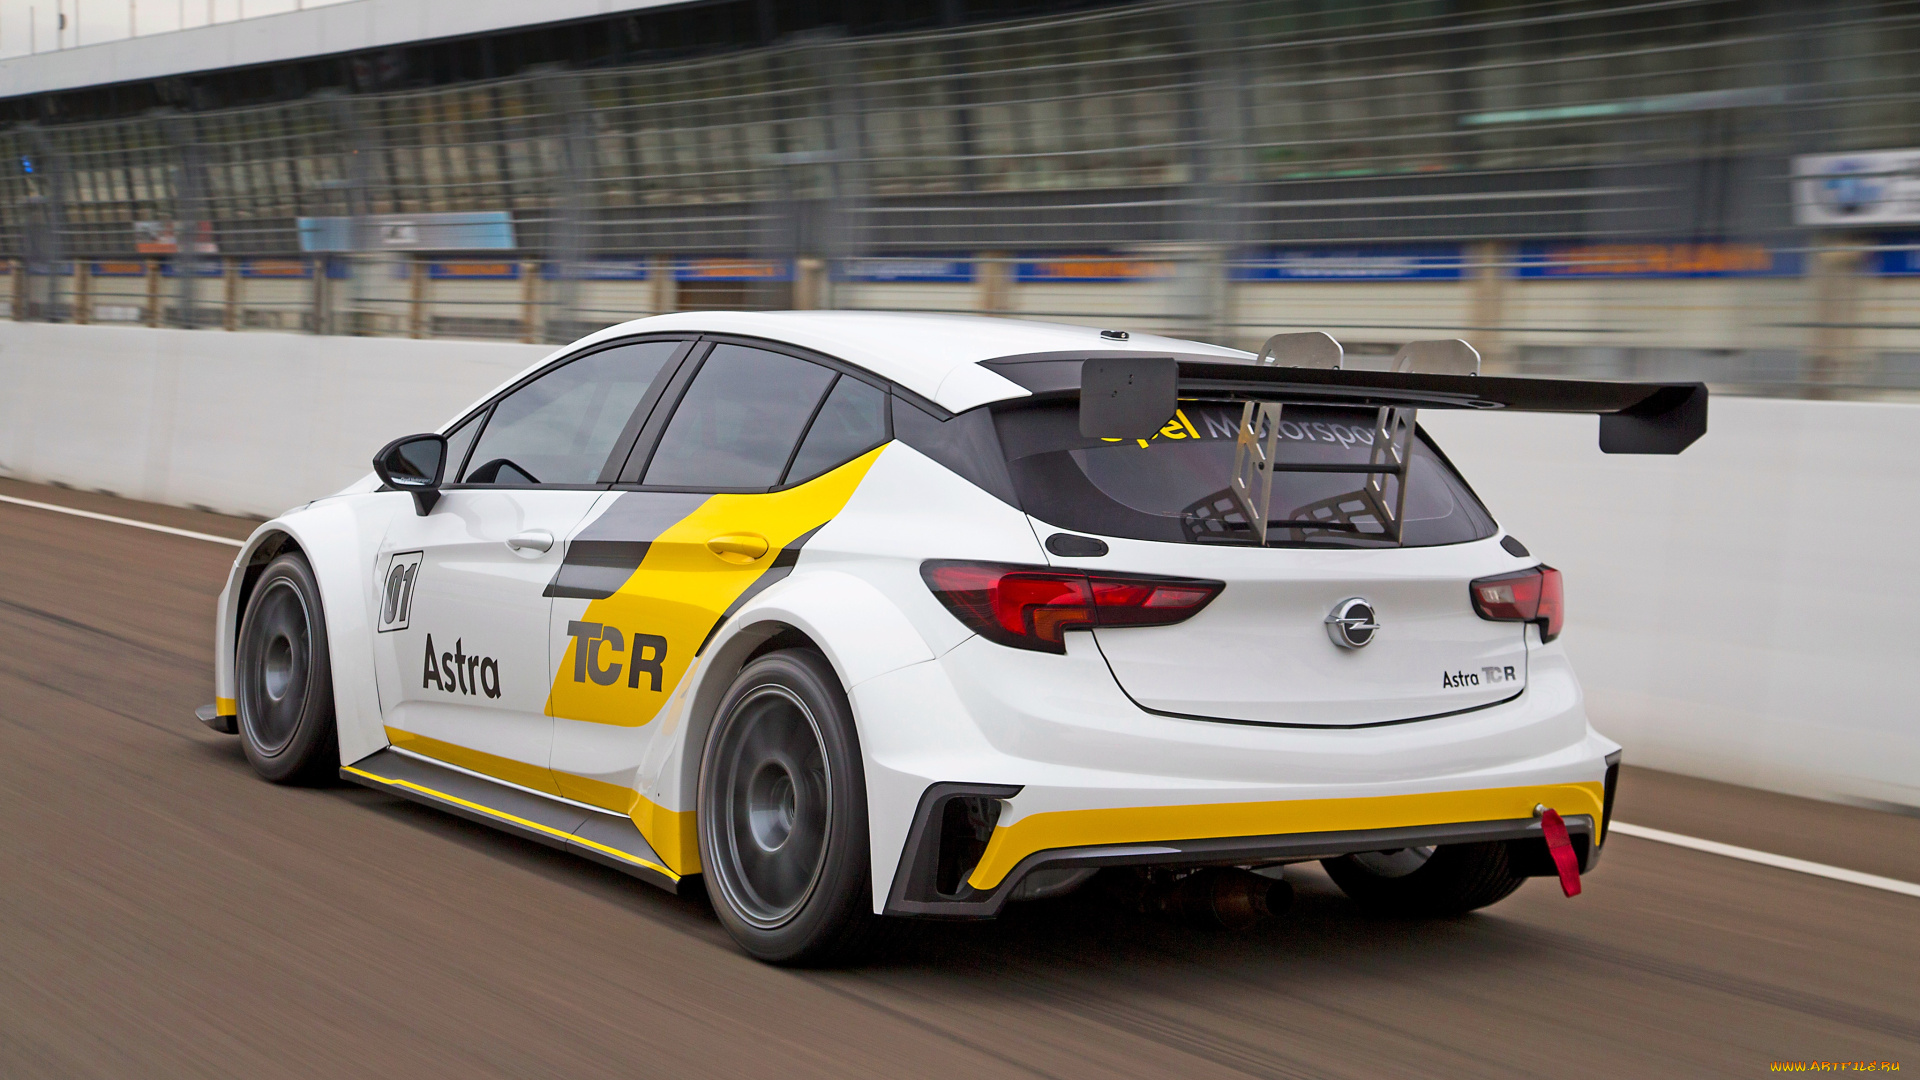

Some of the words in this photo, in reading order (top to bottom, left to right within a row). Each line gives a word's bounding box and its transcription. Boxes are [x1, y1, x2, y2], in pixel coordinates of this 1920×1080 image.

[1100, 408, 1201, 449] el
[383, 562, 418, 625] 01
[422, 633, 502, 700] Astra
[566, 619, 669, 693] TCR
[1443, 670, 1480, 689] Astra
[1481, 666, 1517, 684] TCR
